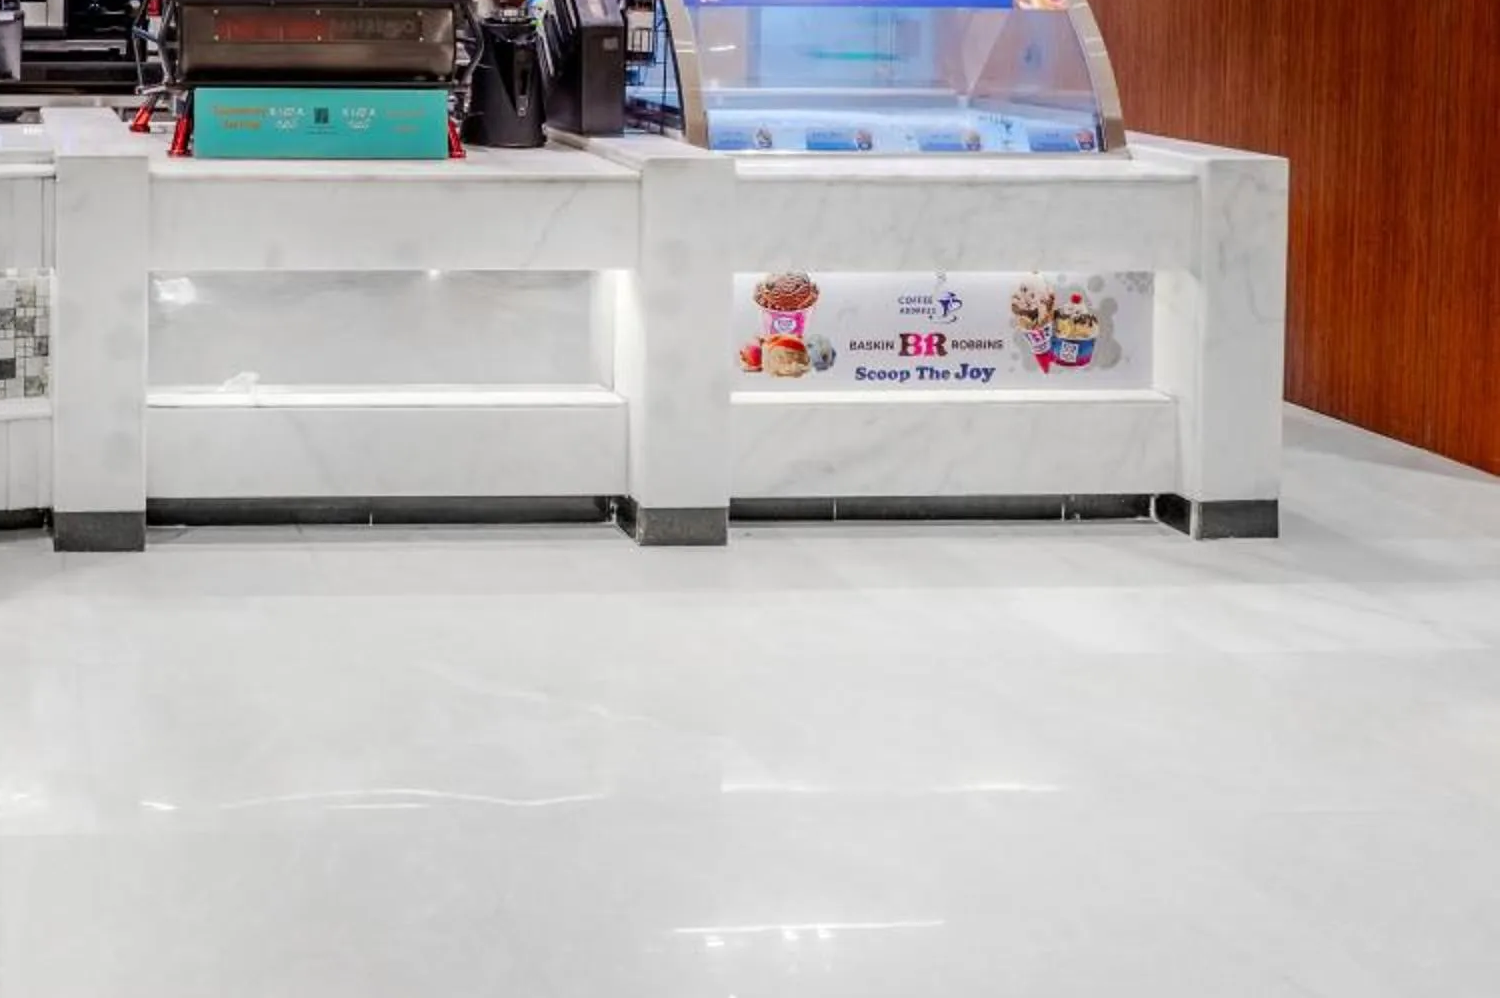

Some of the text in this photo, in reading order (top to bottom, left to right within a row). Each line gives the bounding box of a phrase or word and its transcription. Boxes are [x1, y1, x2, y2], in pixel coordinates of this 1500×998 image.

[897, 295, 933, 305] COFFEE
[849, 333, 1004, 357] BASKIN BR ROBBINS
[854, 362, 997, 383] Scoop The Joy
